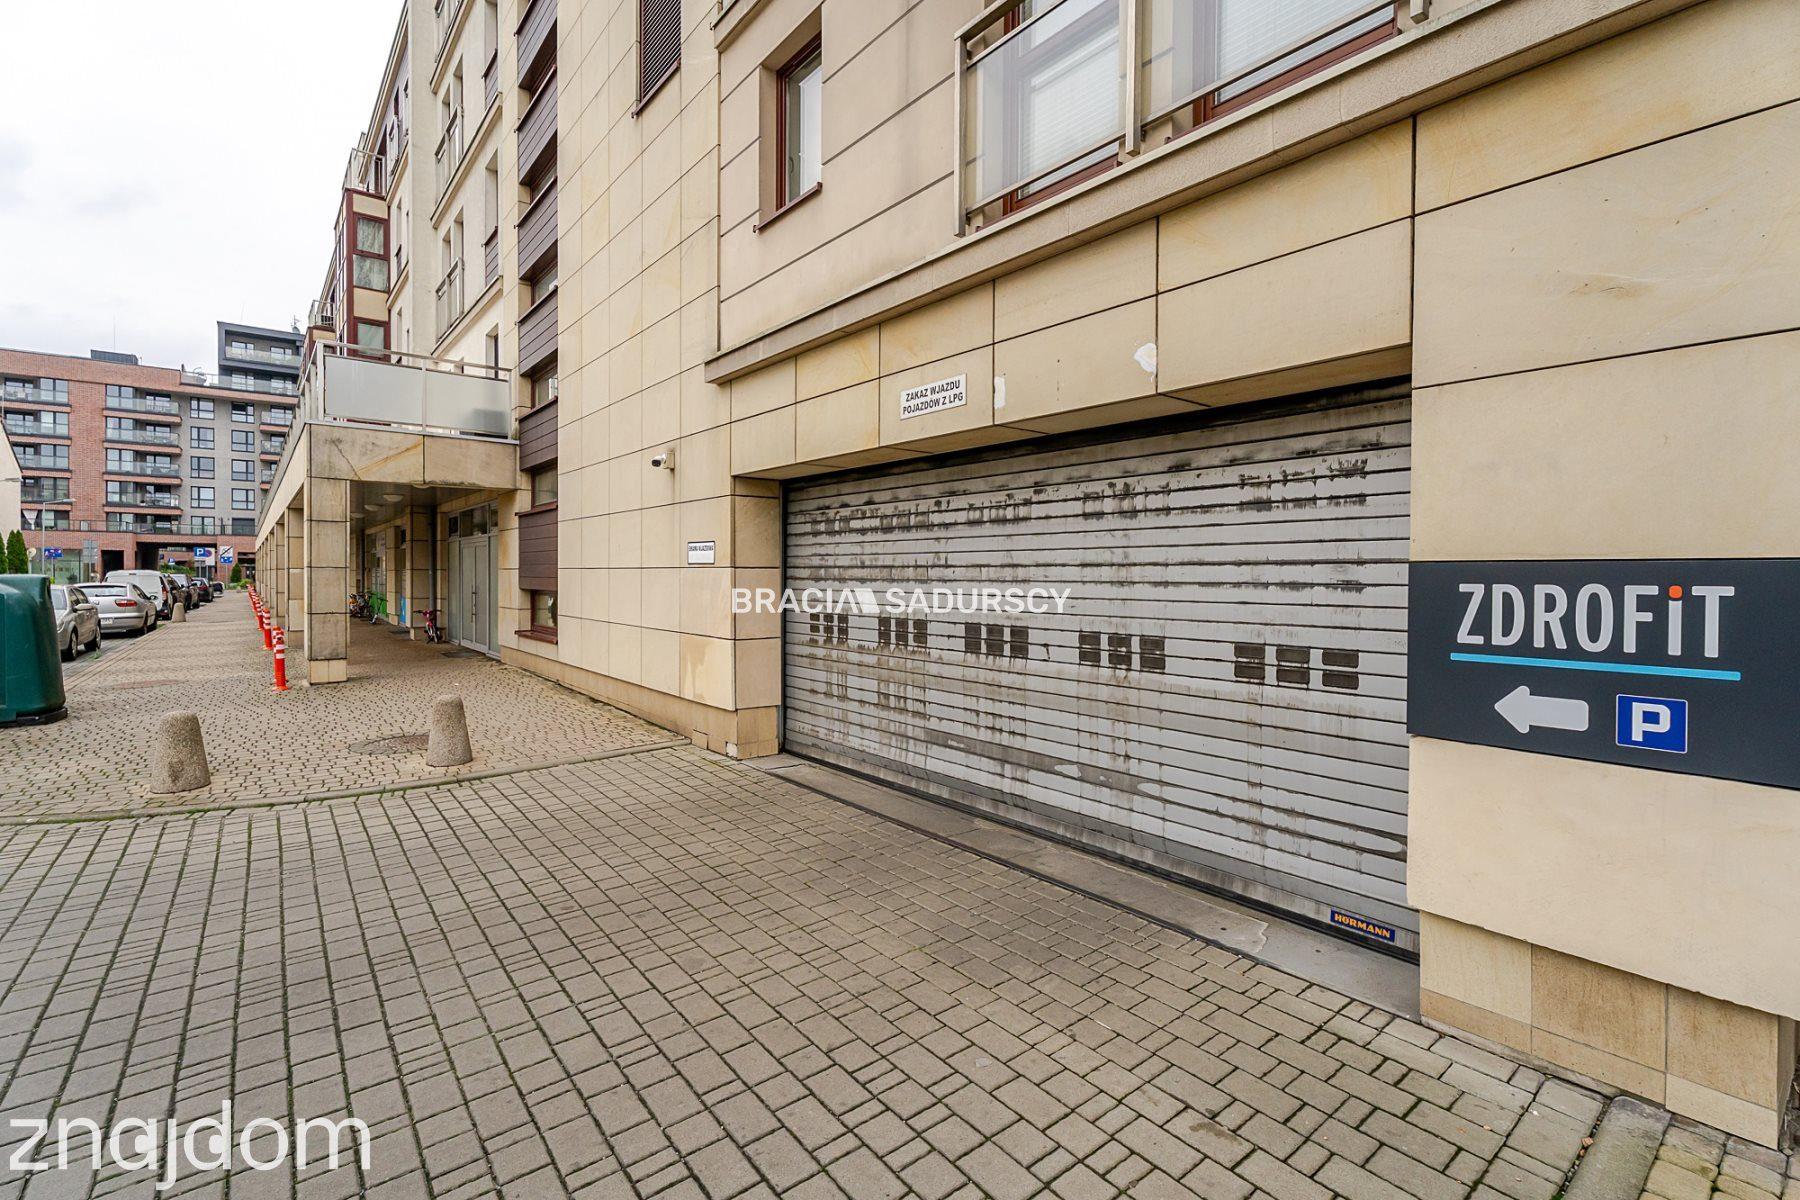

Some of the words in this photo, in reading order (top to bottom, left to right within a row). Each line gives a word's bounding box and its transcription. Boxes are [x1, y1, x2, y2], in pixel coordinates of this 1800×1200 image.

[906, 389, 928, 402] ZAKAZ
[930, 380, 960, 396] WJAZDU
[942, 396, 947, 406] Z
[949, 392, 963, 404] LPG
[1631, 701, 1671, 742] P
